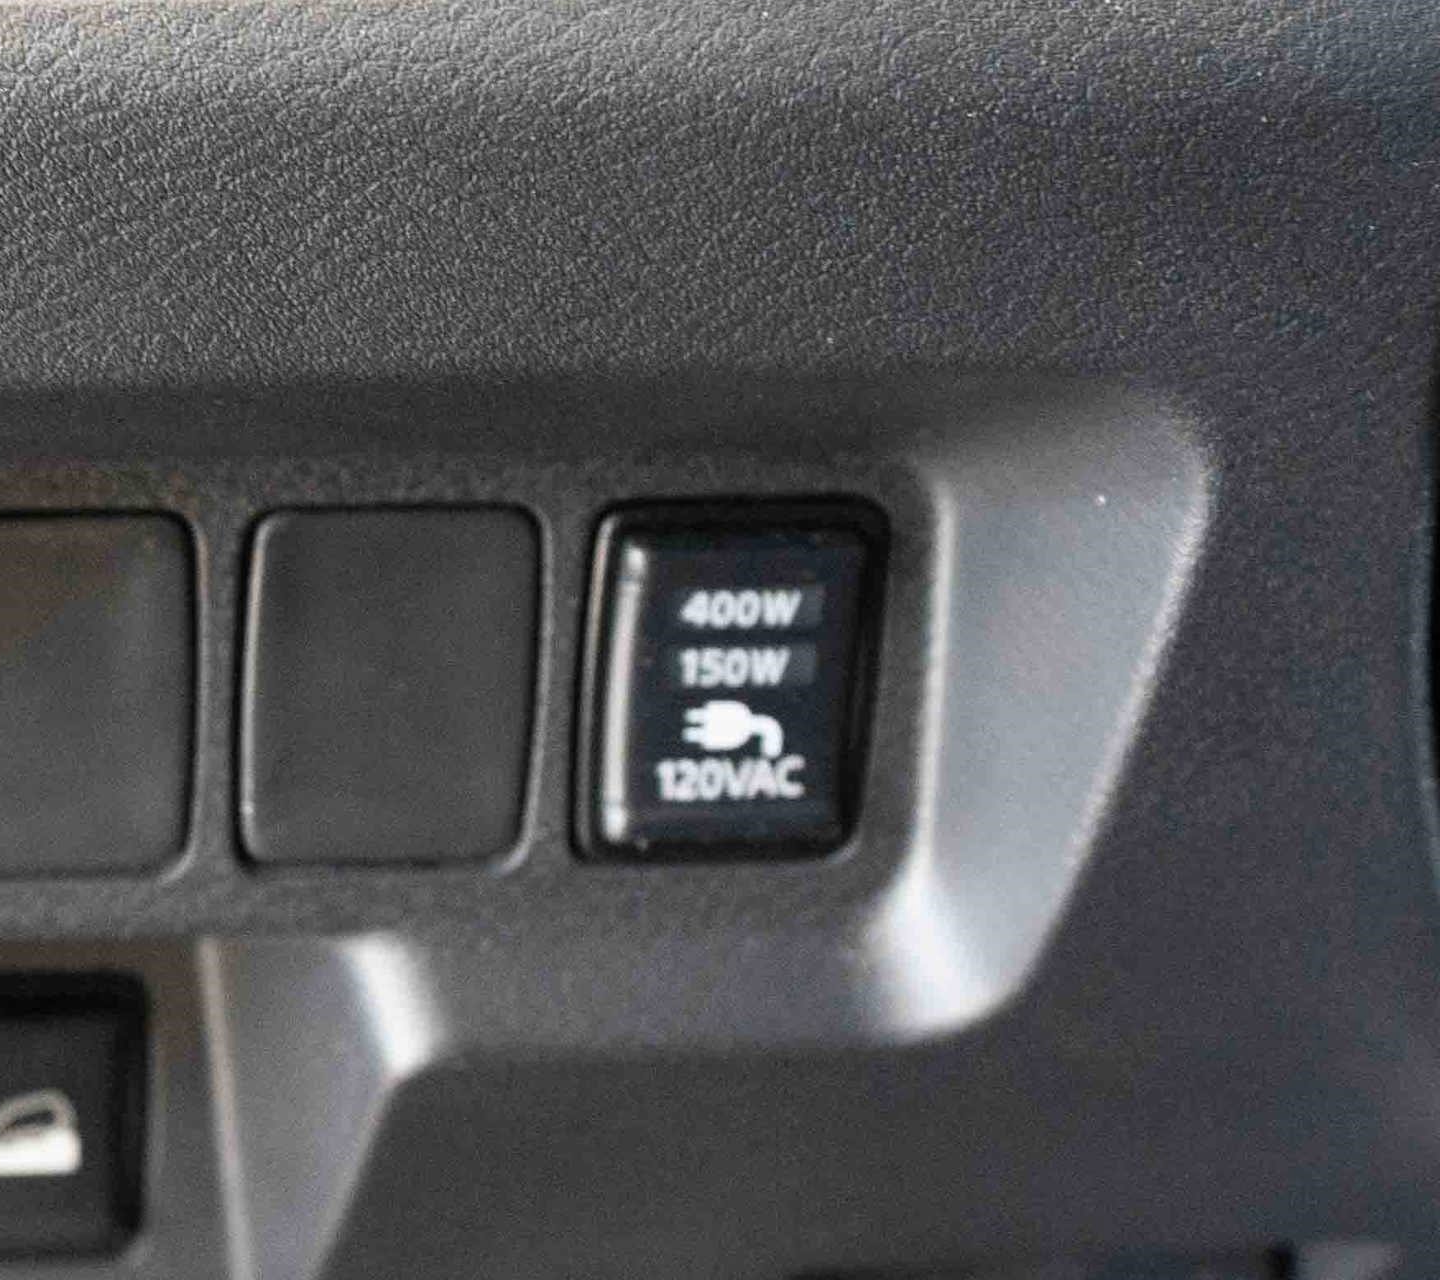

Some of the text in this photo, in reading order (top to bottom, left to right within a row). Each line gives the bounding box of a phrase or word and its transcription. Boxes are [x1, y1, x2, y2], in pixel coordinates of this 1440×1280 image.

[680, 589, 802, 628] 400W
[679, 646, 790, 687] 150W
[656, 754, 805, 801] 120VAC
